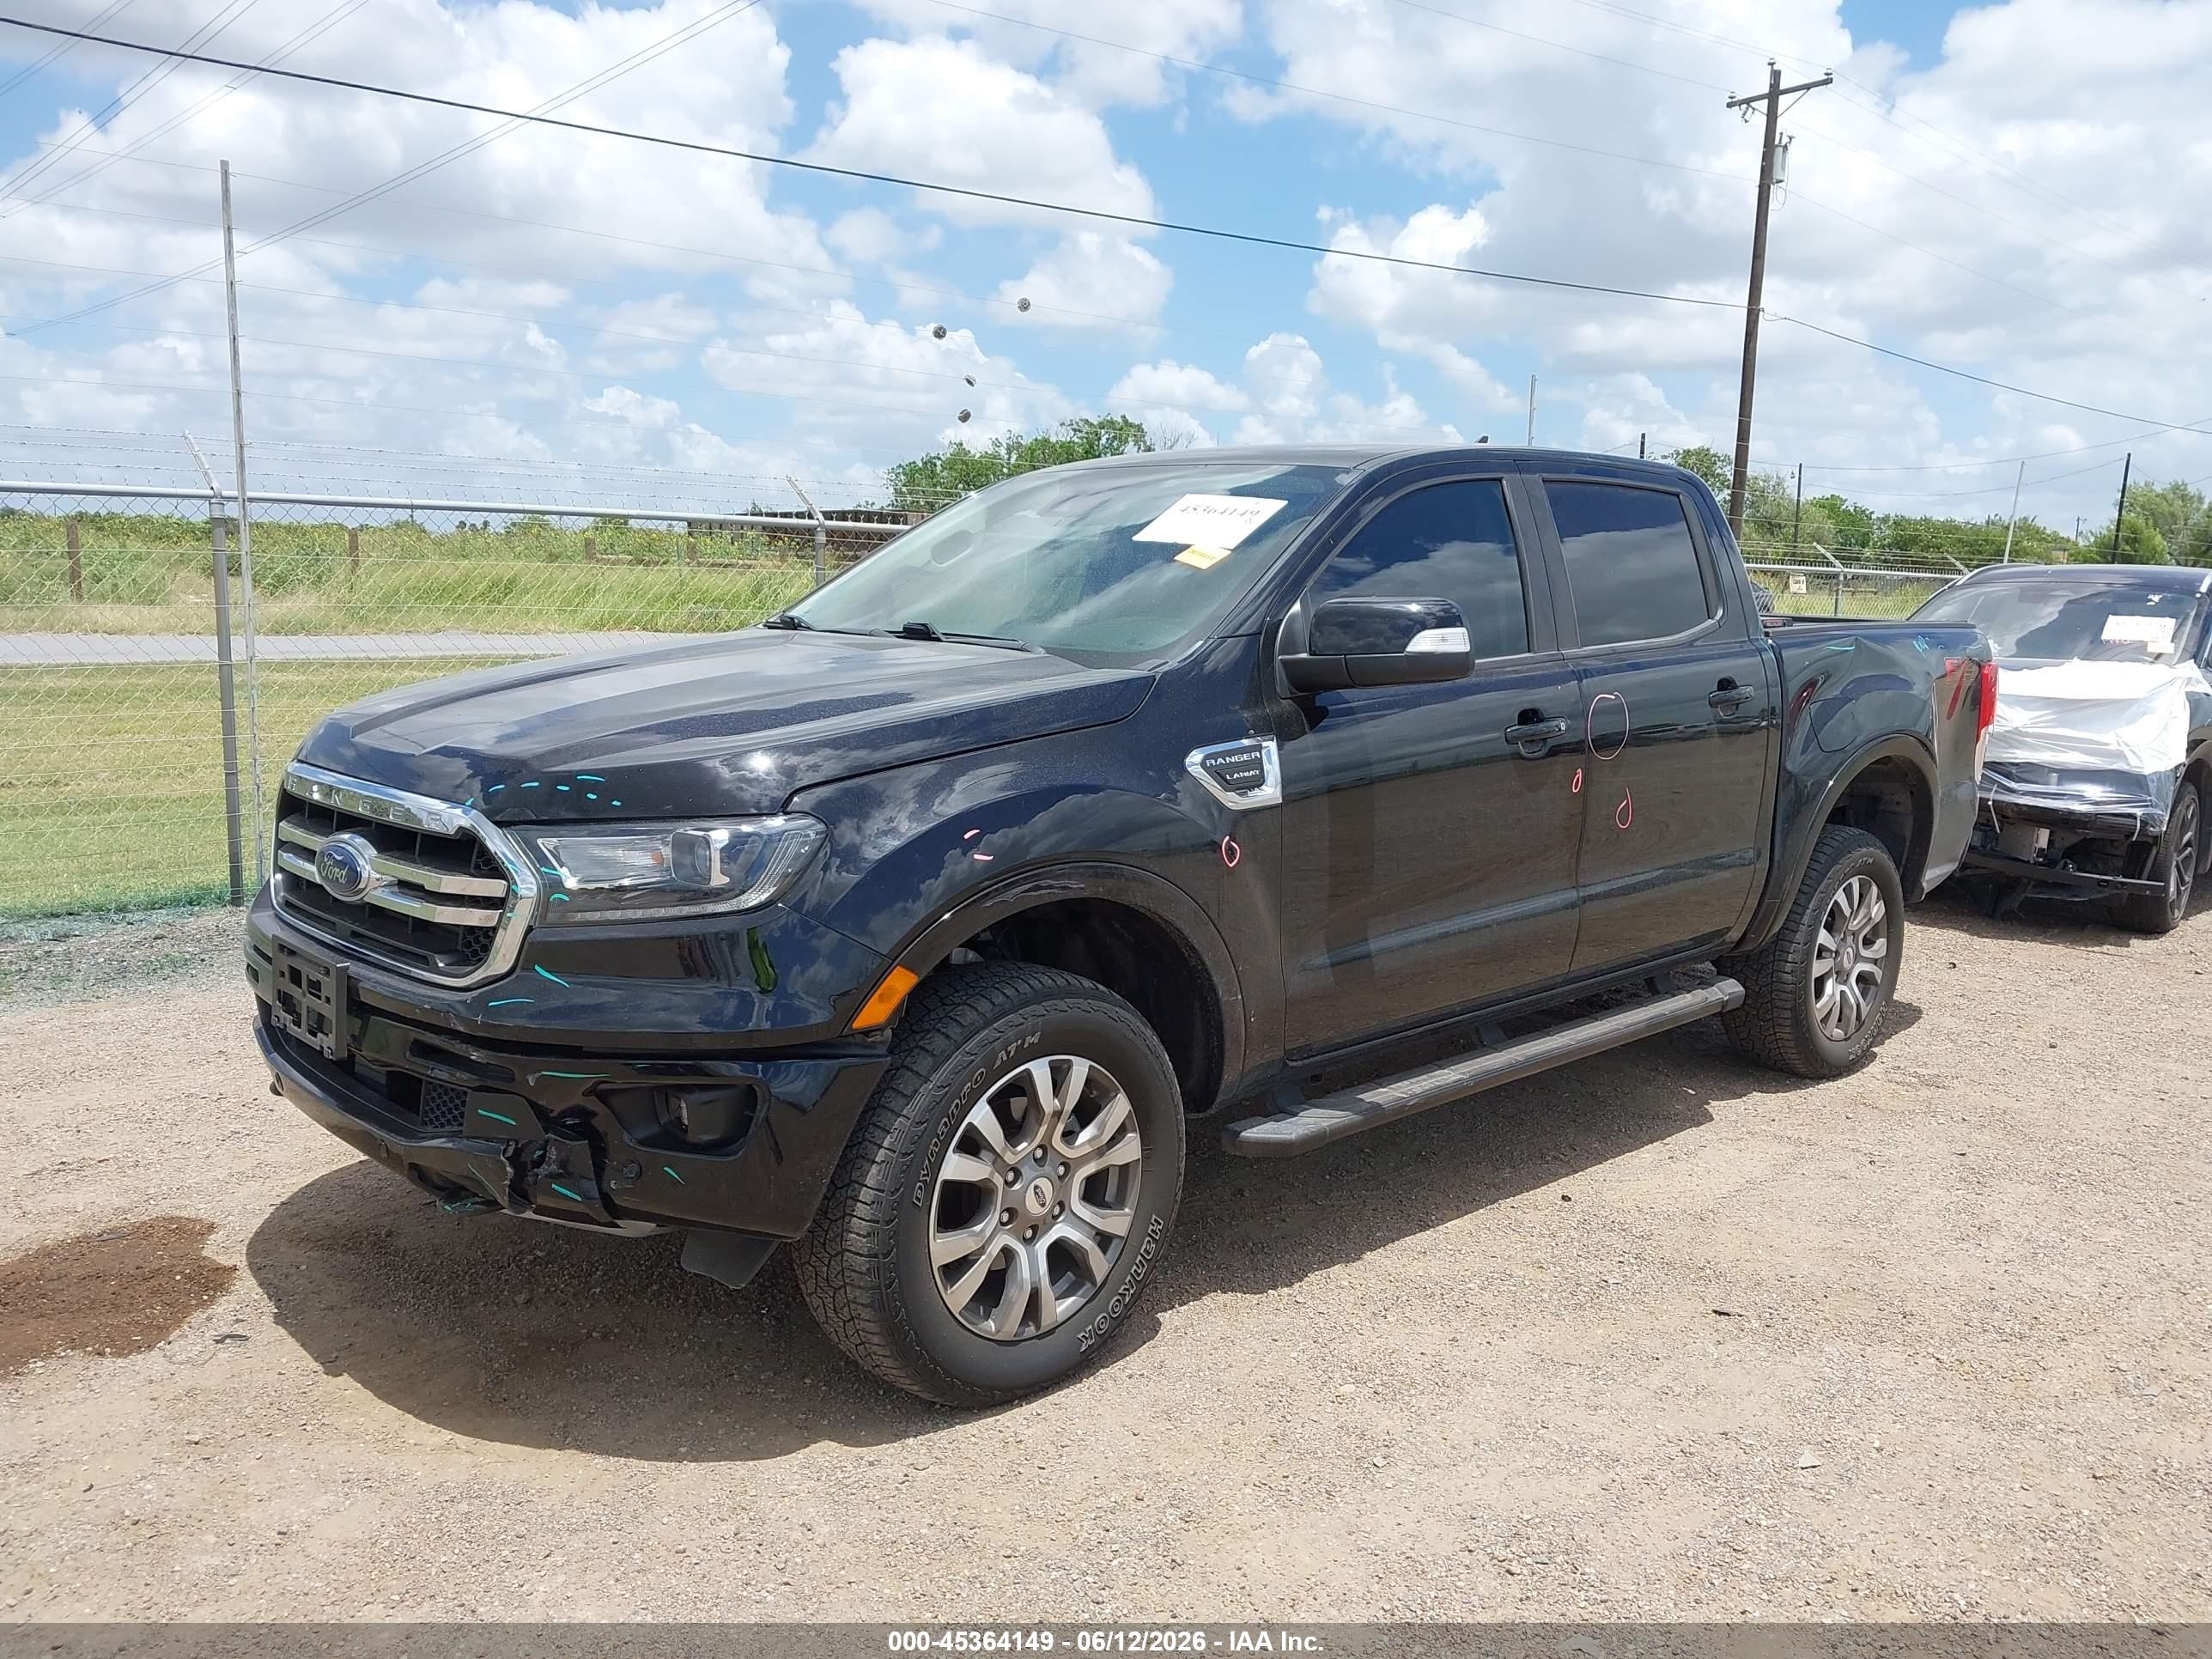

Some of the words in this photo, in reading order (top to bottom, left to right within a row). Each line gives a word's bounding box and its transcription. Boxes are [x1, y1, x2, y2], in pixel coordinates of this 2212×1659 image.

[1206, 751, 1261, 767] RANGER
[1225, 769, 1260, 780] LARIAT
[288, 775, 451, 832] RANGER
[320, 850, 349, 884] Ford
